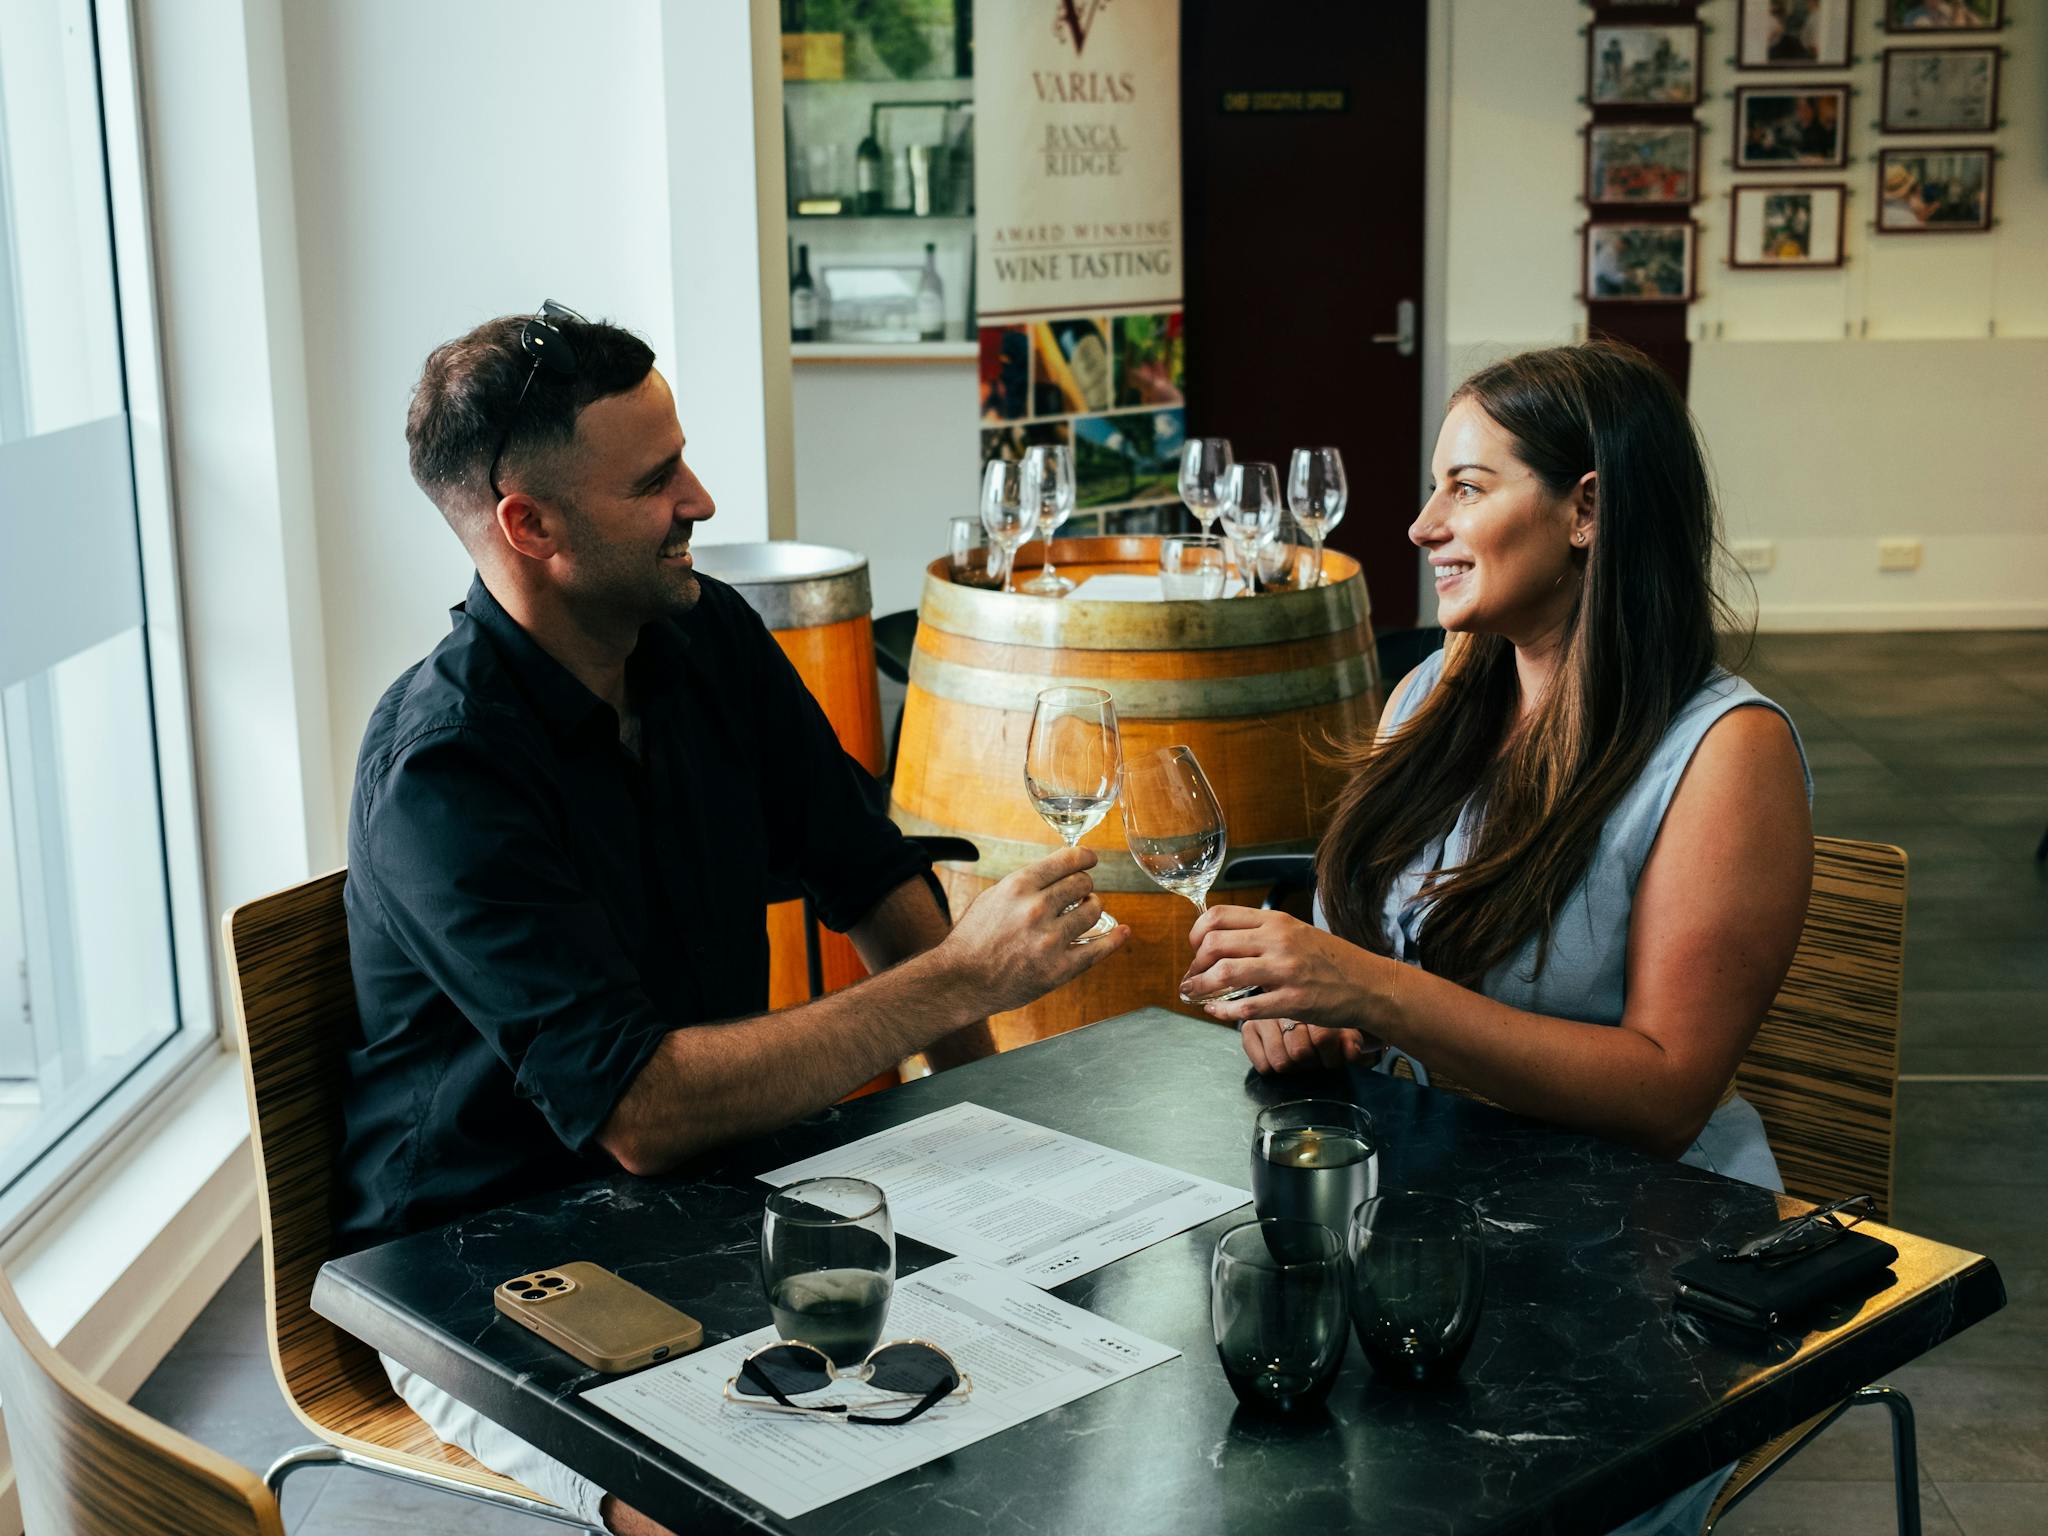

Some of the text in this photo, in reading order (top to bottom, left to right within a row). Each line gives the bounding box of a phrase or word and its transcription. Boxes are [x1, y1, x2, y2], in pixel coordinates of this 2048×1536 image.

[1032, 72, 1137, 103] VARIAS
[1044, 153, 1123, 177] RIDGE
[994, 220, 1170, 243] AWARD WINNING
[993, 248, 1171, 283] WINE TASTING
